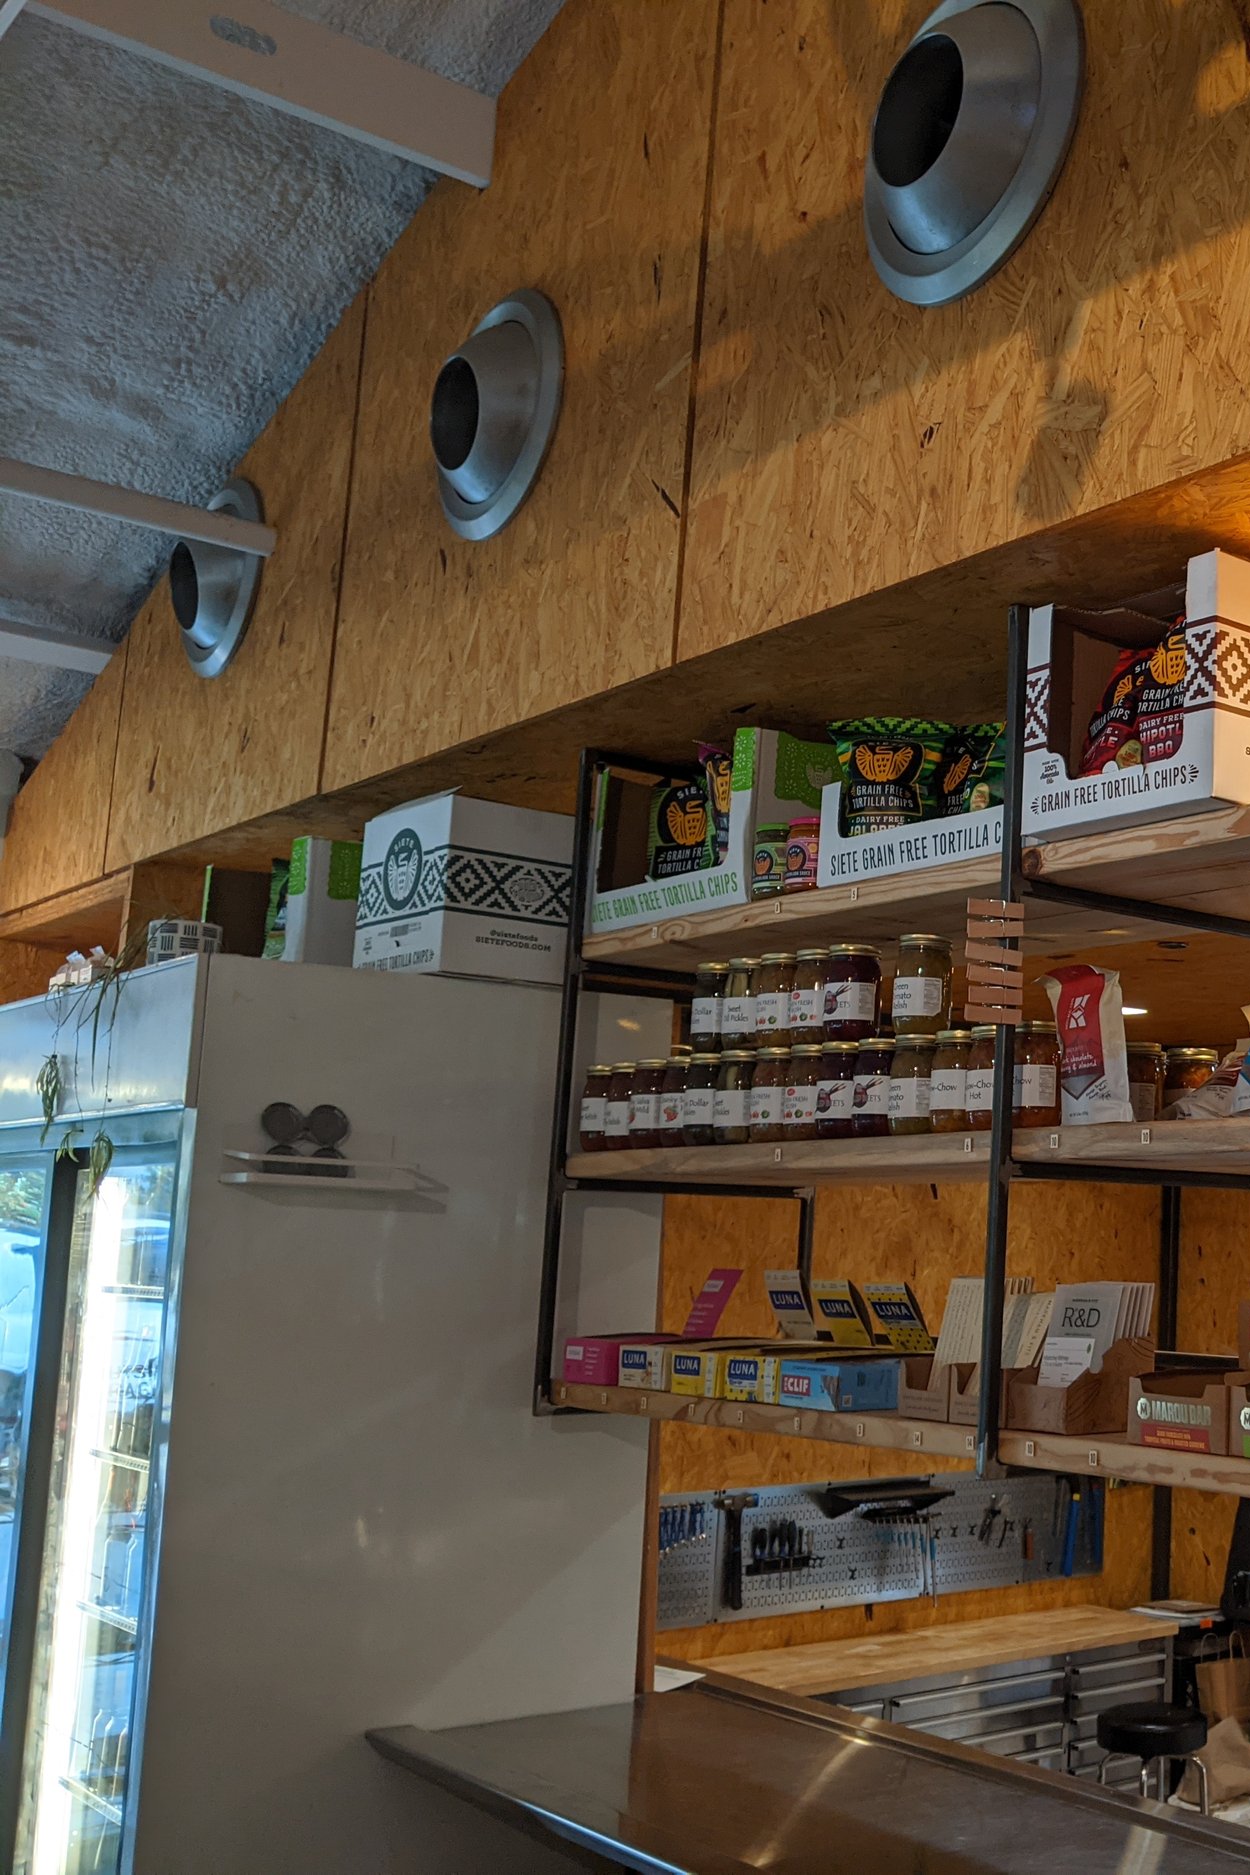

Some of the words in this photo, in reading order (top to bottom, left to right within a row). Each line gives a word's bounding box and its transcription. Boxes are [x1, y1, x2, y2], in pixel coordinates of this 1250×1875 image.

[1143, 687, 1169, 700] GRAIN
[1163, 713, 1184, 724] FREE
[1149, 740, 1173, 758] BBQ
[1044, 764, 1057, 773] 100%
[677, 785, 704, 799] SIE
[856, 784, 882, 796] GRAIN
[885, 784, 904, 798] FREE
[1041, 789, 1071, 813] GRAIN
[1074, 784, 1098, 807] FREE
[1101, 773, 1150, 801] TORTILLA
[1154, 765, 1187, 790] CHIPS
[853, 796, 886, 809] TORTILLA
[888, 795, 914, 808] CHIPS
[856, 816, 881, 824] DAIRY
[883, 816, 905, 824] FREE
[393, 837, 416, 854] SIETE
[831, 851, 858, 876] SIETE
[862, 842, 895, 871] GRAIN
[900, 836, 928, 864] FREE
[932, 824, 989, 856] TORTILLA
[667, 849, 691, 862] GRAIN
[657, 859, 693, 874] TORTILLA
[614, 896, 638, 919] GRAIN
[639, 889, 662, 914] FREE
[663, 879, 705, 909] TORTILLA
[708, 871, 738, 898] CHIPS
[475, 936, 551, 953] SIETEFOODS.COM
[1078, 1062, 1097, 1070] almond
[969, 1092, 981, 1100] Hot
[772, 1293, 801, 1305] LUNA
[821, 1302, 852, 1314] LUNA
[876, 1304, 911, 1317] LUNA
[1062, 1306, 1100, 1328] R&D
[623, 1352, 645, 1365] LUNA
[676, 1358, 699, 1370] LUNA
[730, 1362, 756, 1375] LUNA
[787, 1377, 809, 1392] CLIF
[1152, 1400, 1188, 1424] MAROU
[1188, 1404, 1212, 1426] BAR
